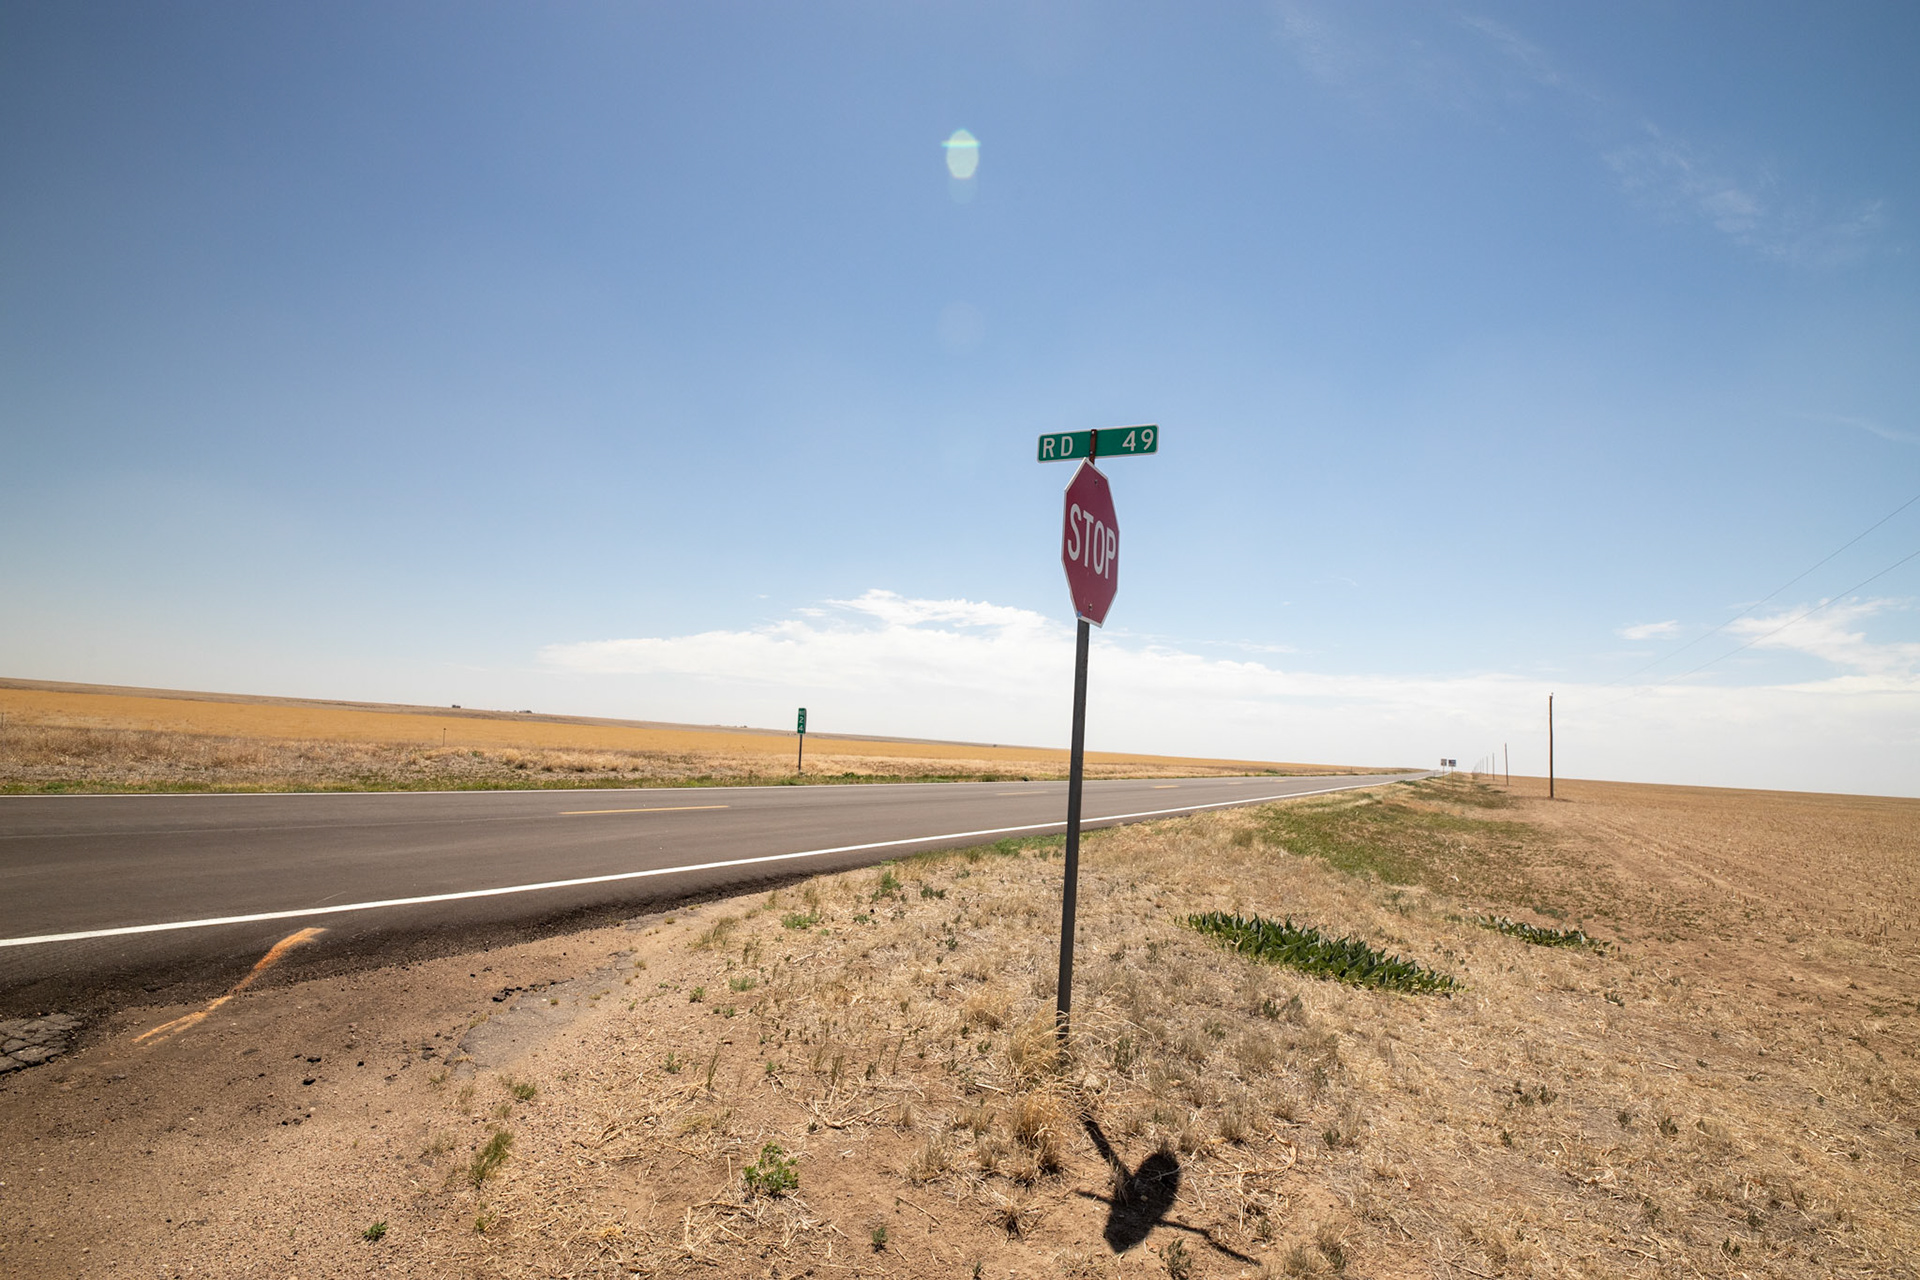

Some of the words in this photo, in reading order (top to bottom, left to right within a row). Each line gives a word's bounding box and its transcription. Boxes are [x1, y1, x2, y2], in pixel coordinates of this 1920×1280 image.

[1042, 436, 1073, 458] RD
[1122, 428, 1154, 451] 49
[1067, 503, 1117, 579] STOP
